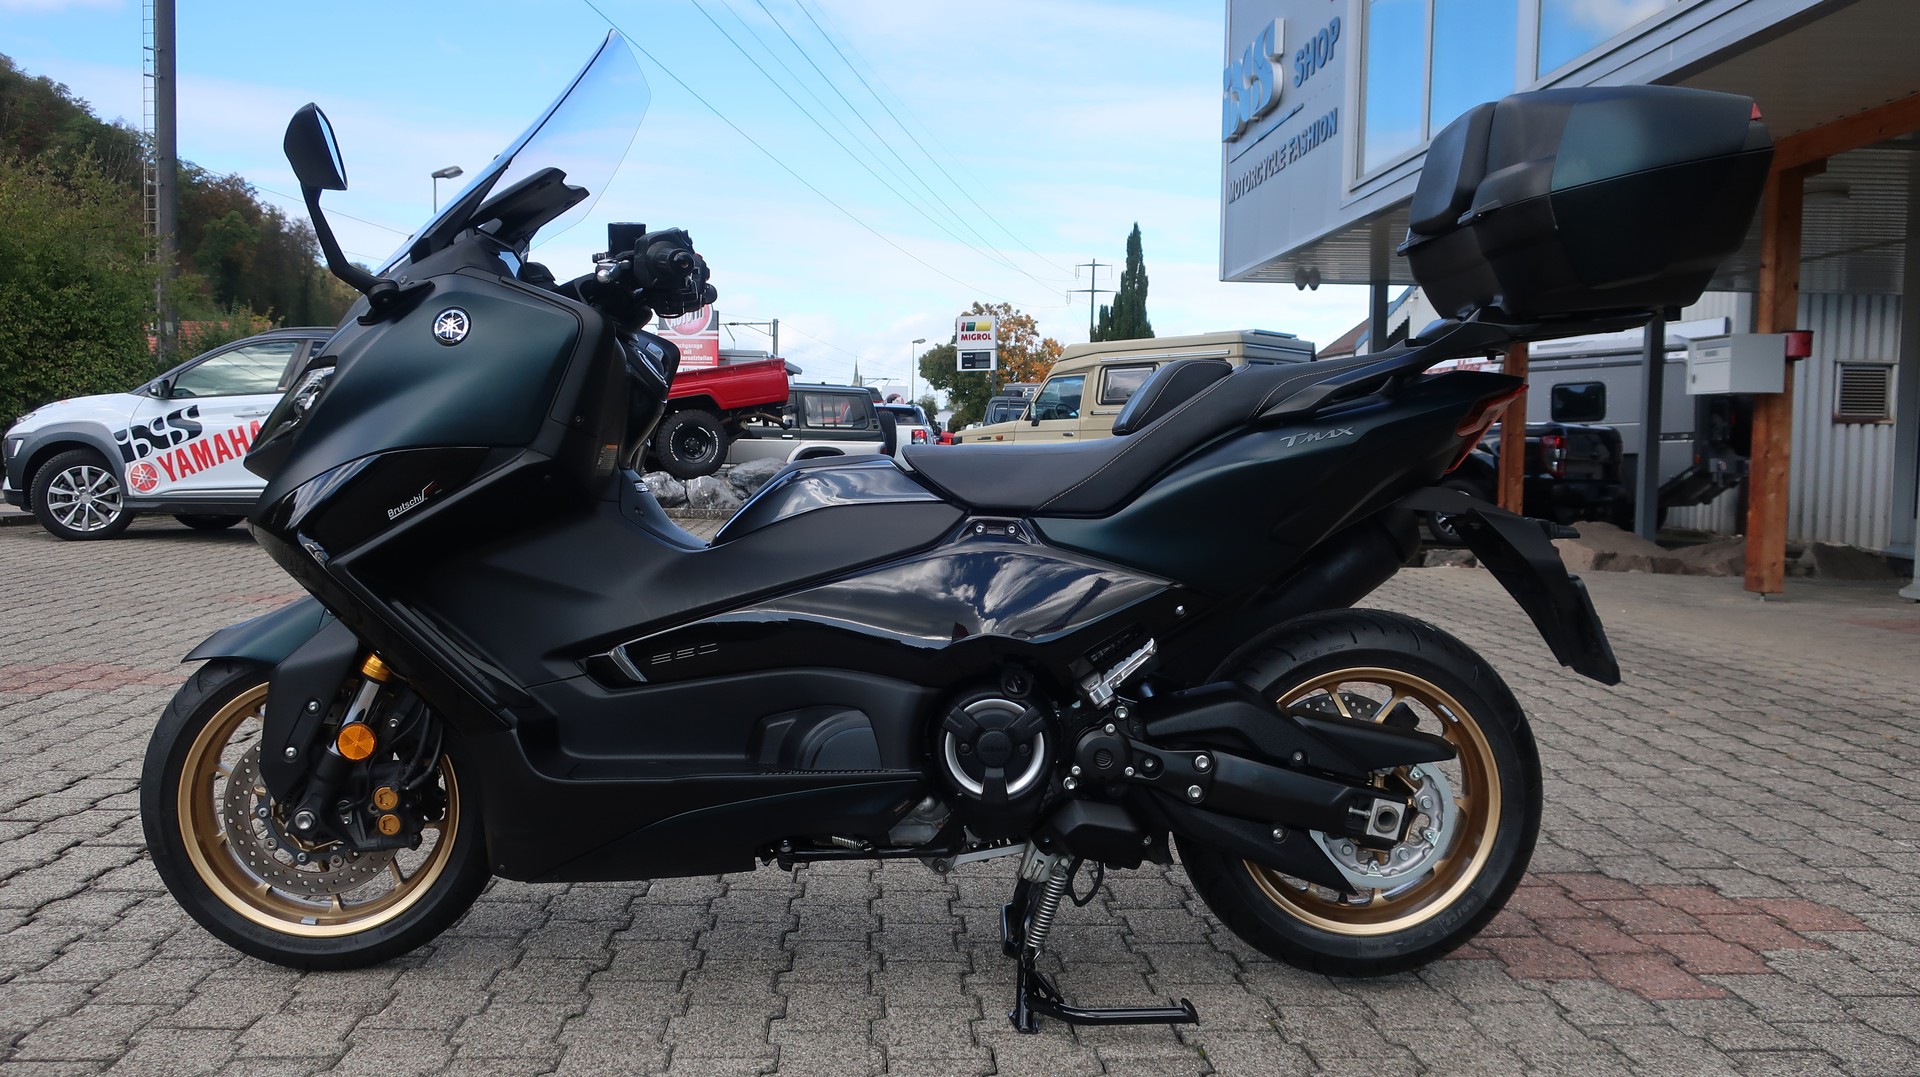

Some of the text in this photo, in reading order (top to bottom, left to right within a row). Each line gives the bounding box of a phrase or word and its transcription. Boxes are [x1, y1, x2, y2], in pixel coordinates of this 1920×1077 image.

[1293, 16, 1341, 88] SHOP
[1229, 107, 1339, 204] MOTORCYCLE FASHION
[960, 333, 992, 341] MIGROL
[1280, 426, 1354, 448] TMAX
[156, 420, 262, 483] YAMAHA
[387, 493, 422, 518] Brutschi
[651, 643, 720, 665] 560
